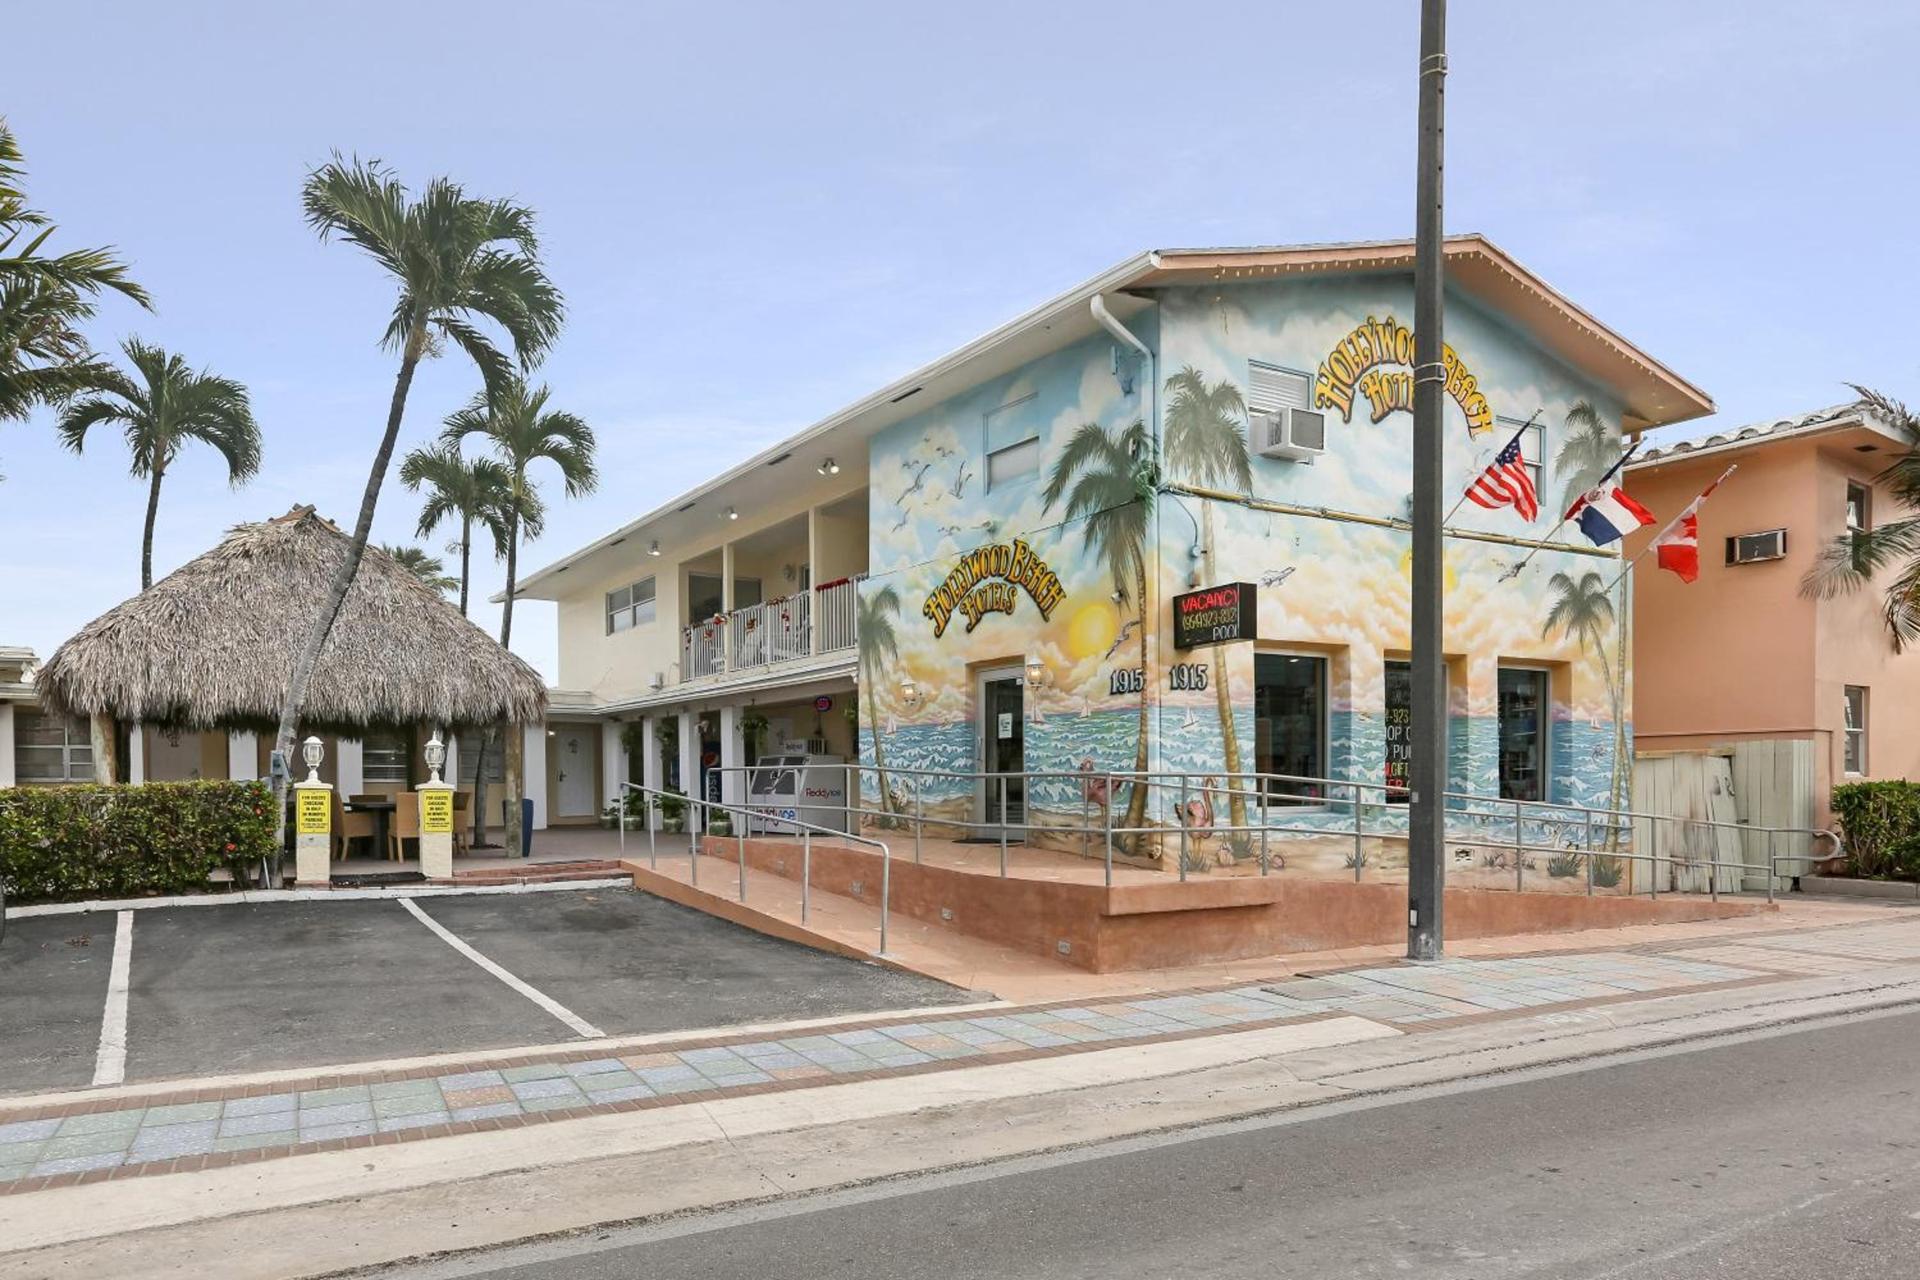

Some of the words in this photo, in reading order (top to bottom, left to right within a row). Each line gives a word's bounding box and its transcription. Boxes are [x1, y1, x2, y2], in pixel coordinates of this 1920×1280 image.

[1315, 316, 1415, 424] HOLLYWO
[923, 544, 1010, 638] HOLLYWOOD
[1004, 539, 1067, 623] BEACH
[959, 582, 1017, 634] HOTELS
[1110, 668, 1144, 695] 1915
[1169, 663, 1208, 691] 1915
